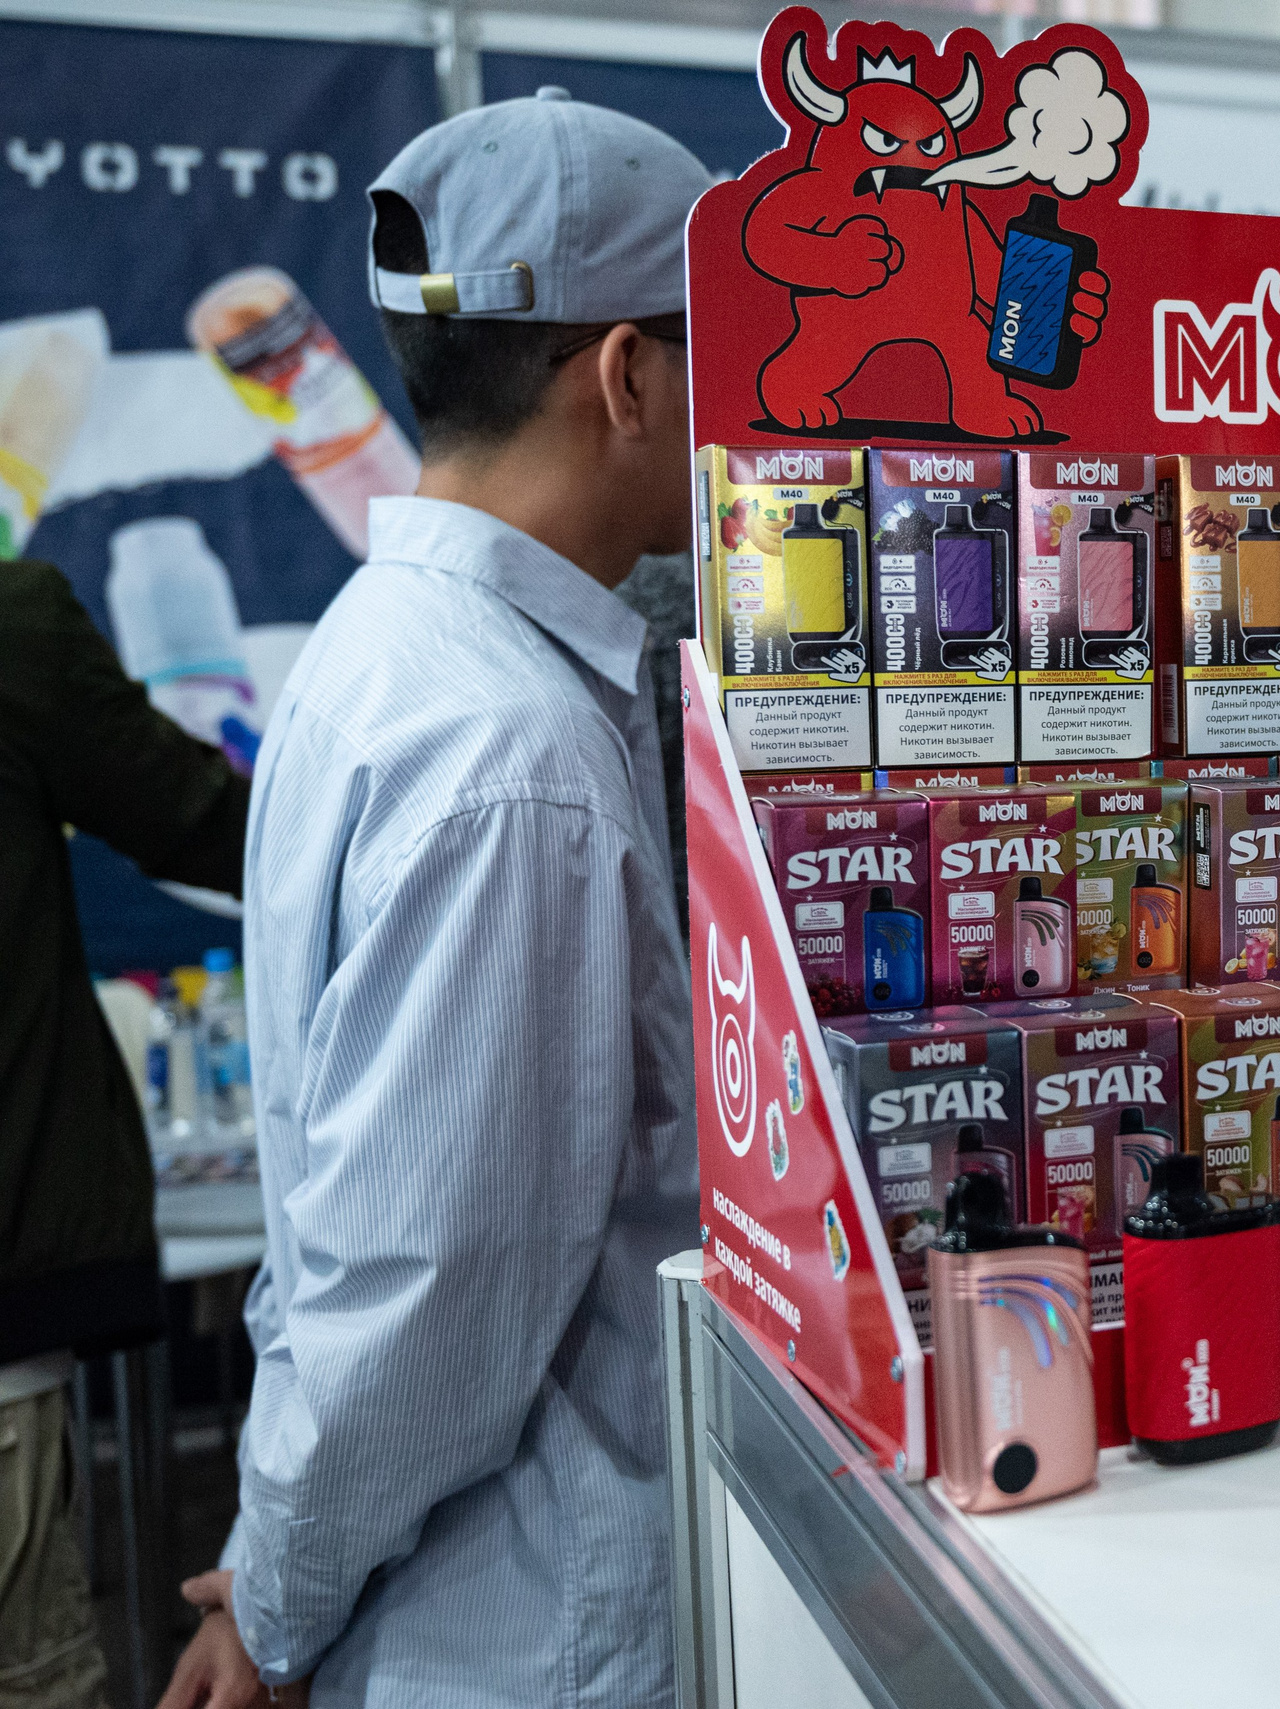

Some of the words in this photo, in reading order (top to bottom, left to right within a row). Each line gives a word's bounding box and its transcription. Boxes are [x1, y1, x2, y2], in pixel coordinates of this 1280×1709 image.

[5, 137, 340, 202] YOTTO
[998, 300, 1022, 361] MON
[756, 450, 824, 480] MON
[909, 454, 975, 482] MON
[1056, 456, 1118, 485] MON
[1216, 459, 1273, 487] MON
[780, 490, 803, 499] M40
[933, 492, 954, 500] M40
[1236, 496, 1255, 504] M40
[844, 662, 860, 674] x5
[735, 694, 861, 708] ПРЕДУПРЕЖДЕНИЕ:
[886, 692, 1006, 705] ПРЕДУПРЕЖДЕНИЕ:
[1029, 690, 1144, 703] ПРЕДУПРЕЖДЕНИЕ:
[1212, 699, 1247, 710] Данный
[756, 711, 797, 723] Данный
[800, 711, 842, 722] продукт
[905, 708, 945, 719] Данный
[948, 708, 988, 718] продукт
[1047, 706, 1085, 716] Данный
[1088, 706, 1126, 716] продукт
[1206, 714, 1249, 723] содержит
[749, 727, 799, 737] содержит
[803, 725, 849, 734] никотин.
[899, 723, 947, 733] содержит
[950, 722, 995, 730] никотин.
[1041, 721, 1087, 730] содержит
[1207, 727, 1245, 735] Никотин
[751, 740, 796, 750] Никотин
[799, 739, 848, 748] вызывает
[900, 737, 943, 746] Никотин
[946, 736, 994, 744] вызывает
[1042, 734, 1083, 742] Никотин
[1220, 740, 1278, 748] зависимость.
[766, 754, 835, 764] зависимость.
[914, 751, 980, 760] зависимость.
[1055, 747, 1118, 755] зависимость.
[979, 800, 1027, 822] MON
[1100, 791, 1144, 812] MON
[826, 808, 877, 831] MON
[1076, 826, 1177, 866] STAR
[786, 846, 917, 889] STAR
[941, 838, 1065, 880] STAR
[1237, 907, 1276, 926] 50000
[951, 924, 993, 943] 50000
[799, 936, 843, 955] 50000
[1127, 984, 1150, 992] Тоник
[1076, 1025, 1127, 1051] MON
[911, 1041, 966, 1067] MON
[1035, 1064, 1167, 1117] STAR
[869, 1079, 1009, 1133] STAR
[1206, 1145, 1250, 1168] 50000
[1047, 1161, 1093, 1183] 50000
[883, 1179, 931, 1203] 50000
[713, 1187, 782, 1264] наслаждение
[714, 1236, 753, 1290] каждой
[754, 1271, 801, 1333] затяжке
[1187, 1364, 1210, 1427] MON
